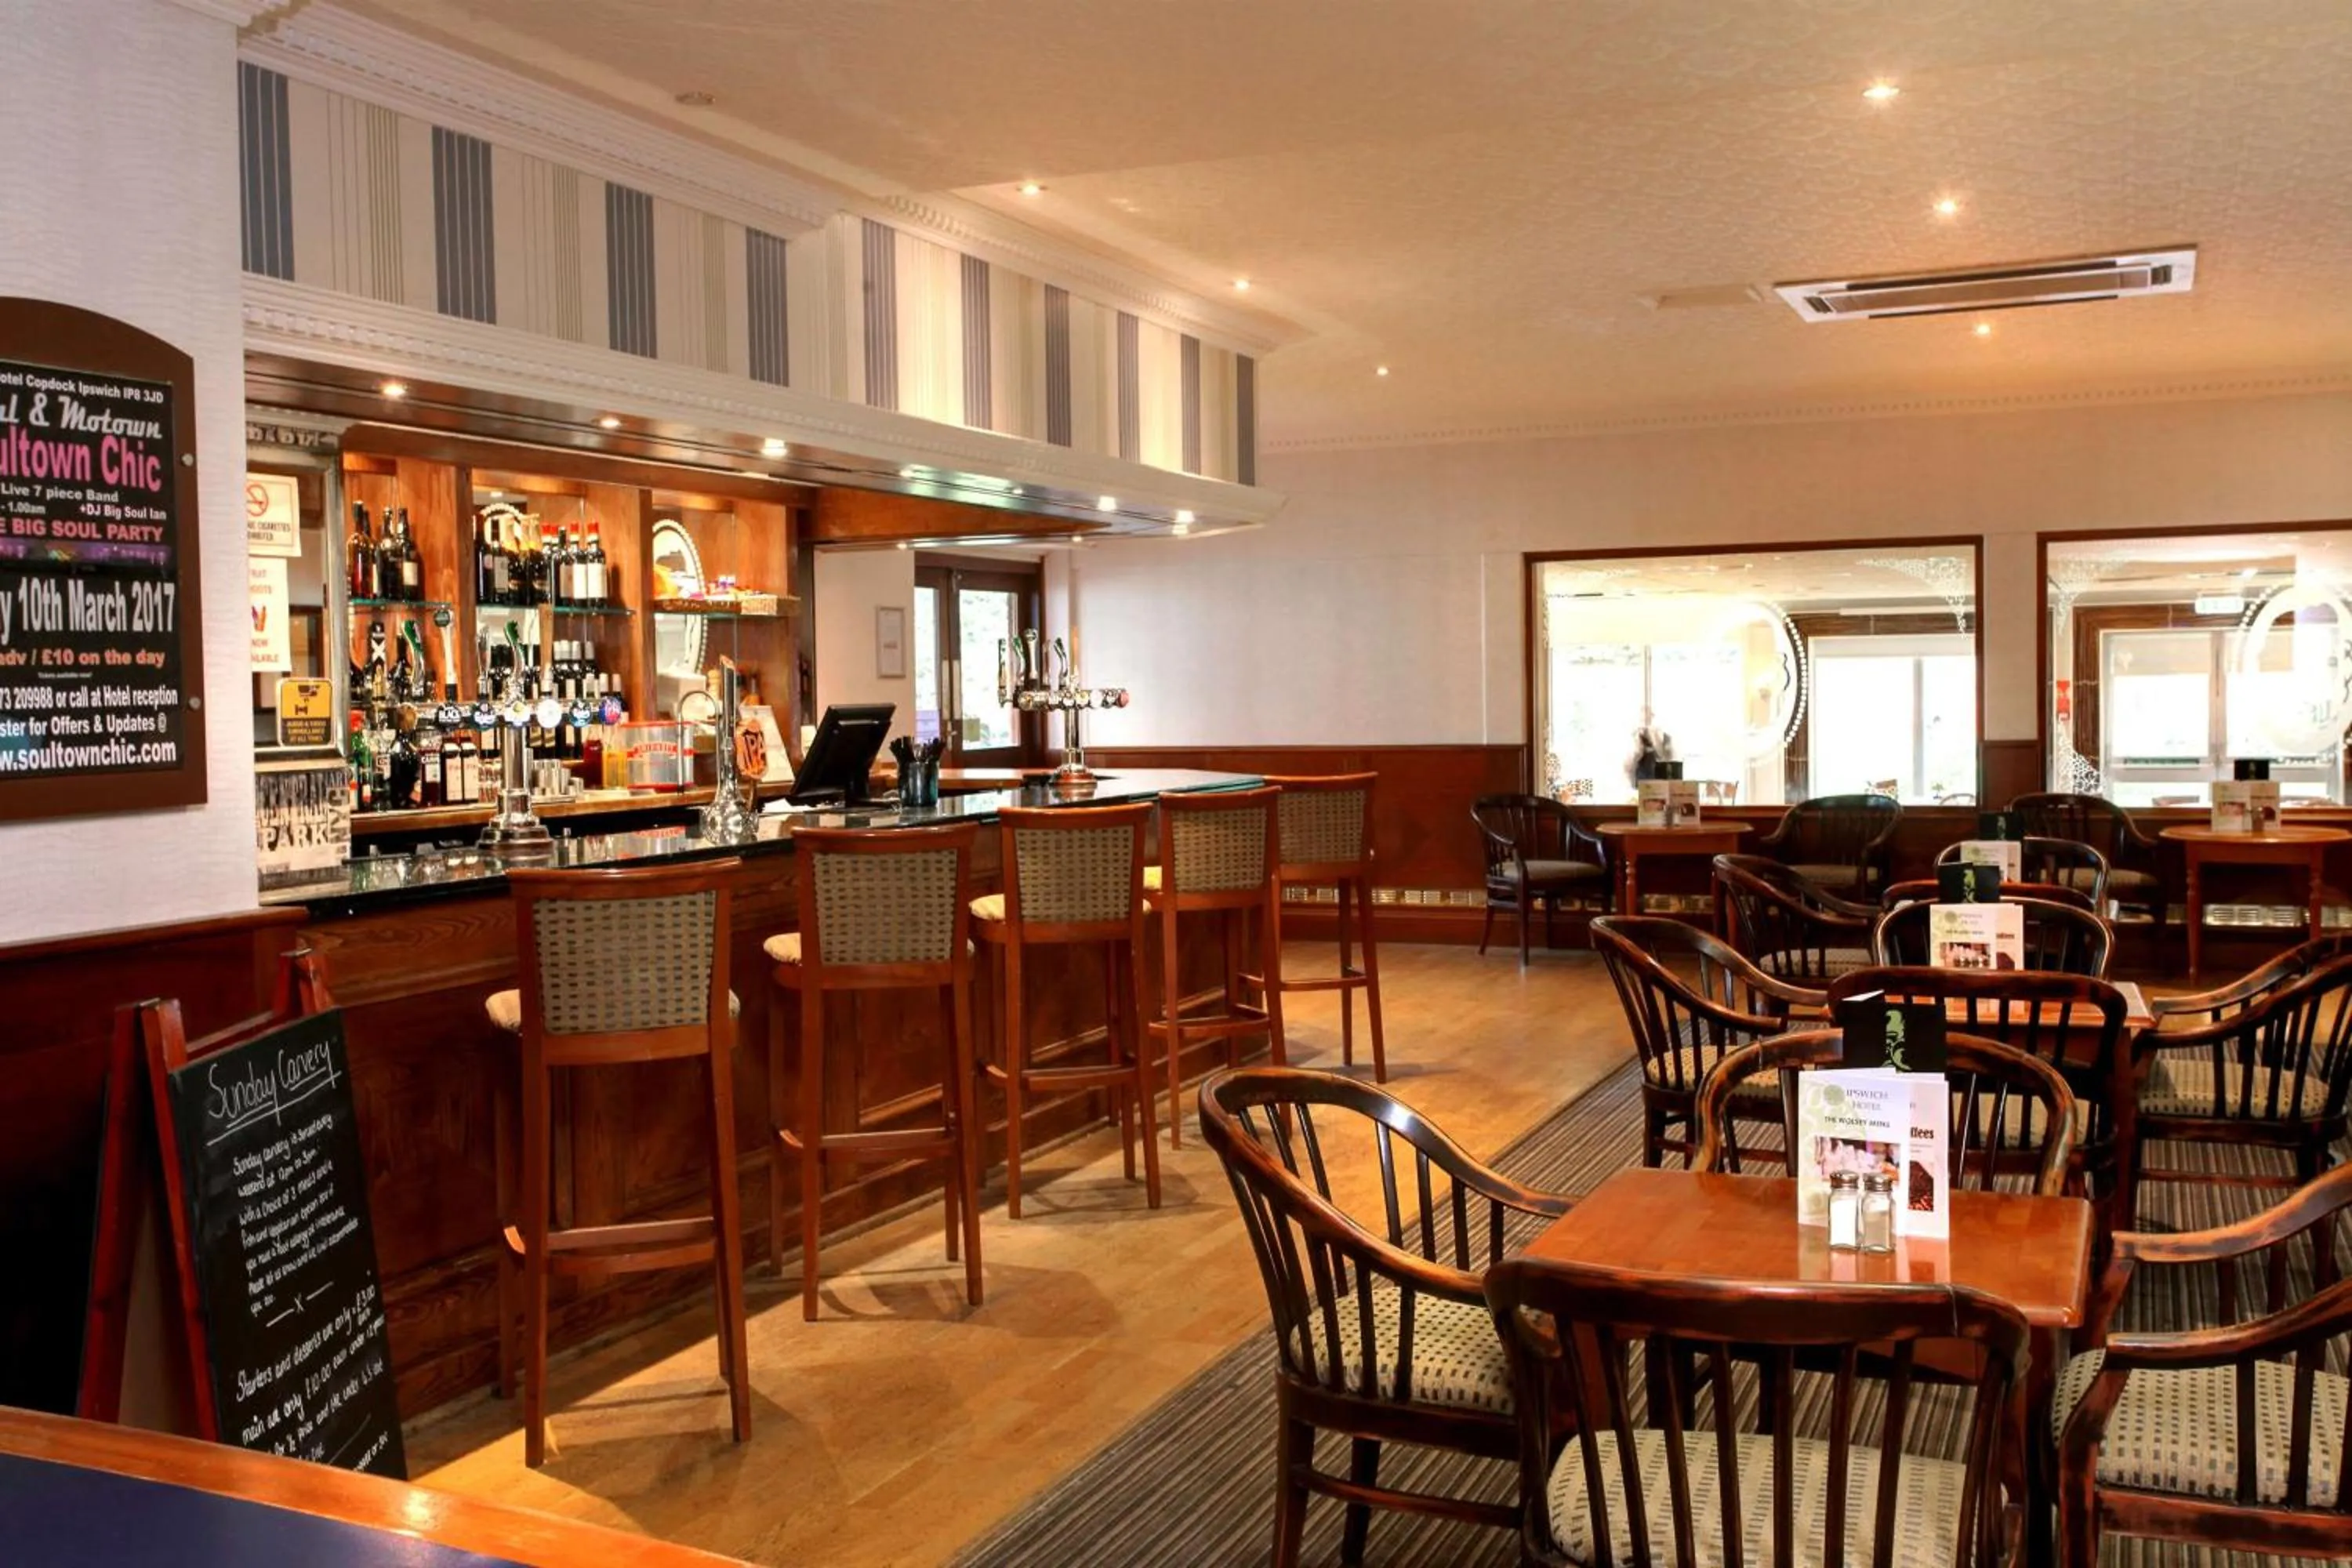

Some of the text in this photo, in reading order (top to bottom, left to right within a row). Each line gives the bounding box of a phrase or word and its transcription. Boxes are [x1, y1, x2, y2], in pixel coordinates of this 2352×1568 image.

[26, 374, 75, 392] Copdock
[79, 381, 120, 397] Ipswich
[124, 390, 140, 401] IP8
[29, 393, 50, 427] &
[58, 396, 162, 439] Motown
[100, 435, 162, 492] Chic
[1, 482, 119, 503] Live 7 piece Band
[104, 506, 122, 520] Big
[125, 506, 147, 518] Soul
[150, 508, 167, 521] Ian
[12, 517, 47, 536] BIG
[52, 521, 102, 539] SOUL
[107, 524, 163, 542] PARTY
[18, 576, 64, 632] 10th
[67, 579, 127, 632] March
[132, 581, 175, 633] 2017
[42, 648, 74, 666] £10
[78, 652, 100, 666] on
[104, 649, 132, 666] the
[136, 648, 165, 669] day
[14, 687, 53, 710] 209988
[56, 691, 67, 709] or
[69, 686, 88, 709] call
[91, 688, 101, 708] at
[103, 685, 130, 707] Hotel
[132, 684, 178, 711] reception
[29, 717, 48, 736] for
[51, 714, 90, 735] Offers
[93, 714, 103, 733] &
[107, 713, 155, 736] Updates
[263, 823, 328, 848] PARK
[208, 1040, 337, 1127] Sunday Carvery
[1846, 1089, 1889, 1099] IPSWICH
[1852, 1100, 1882, 1111] HOTEL
[1824, 1116, 1837, 1124] THE
